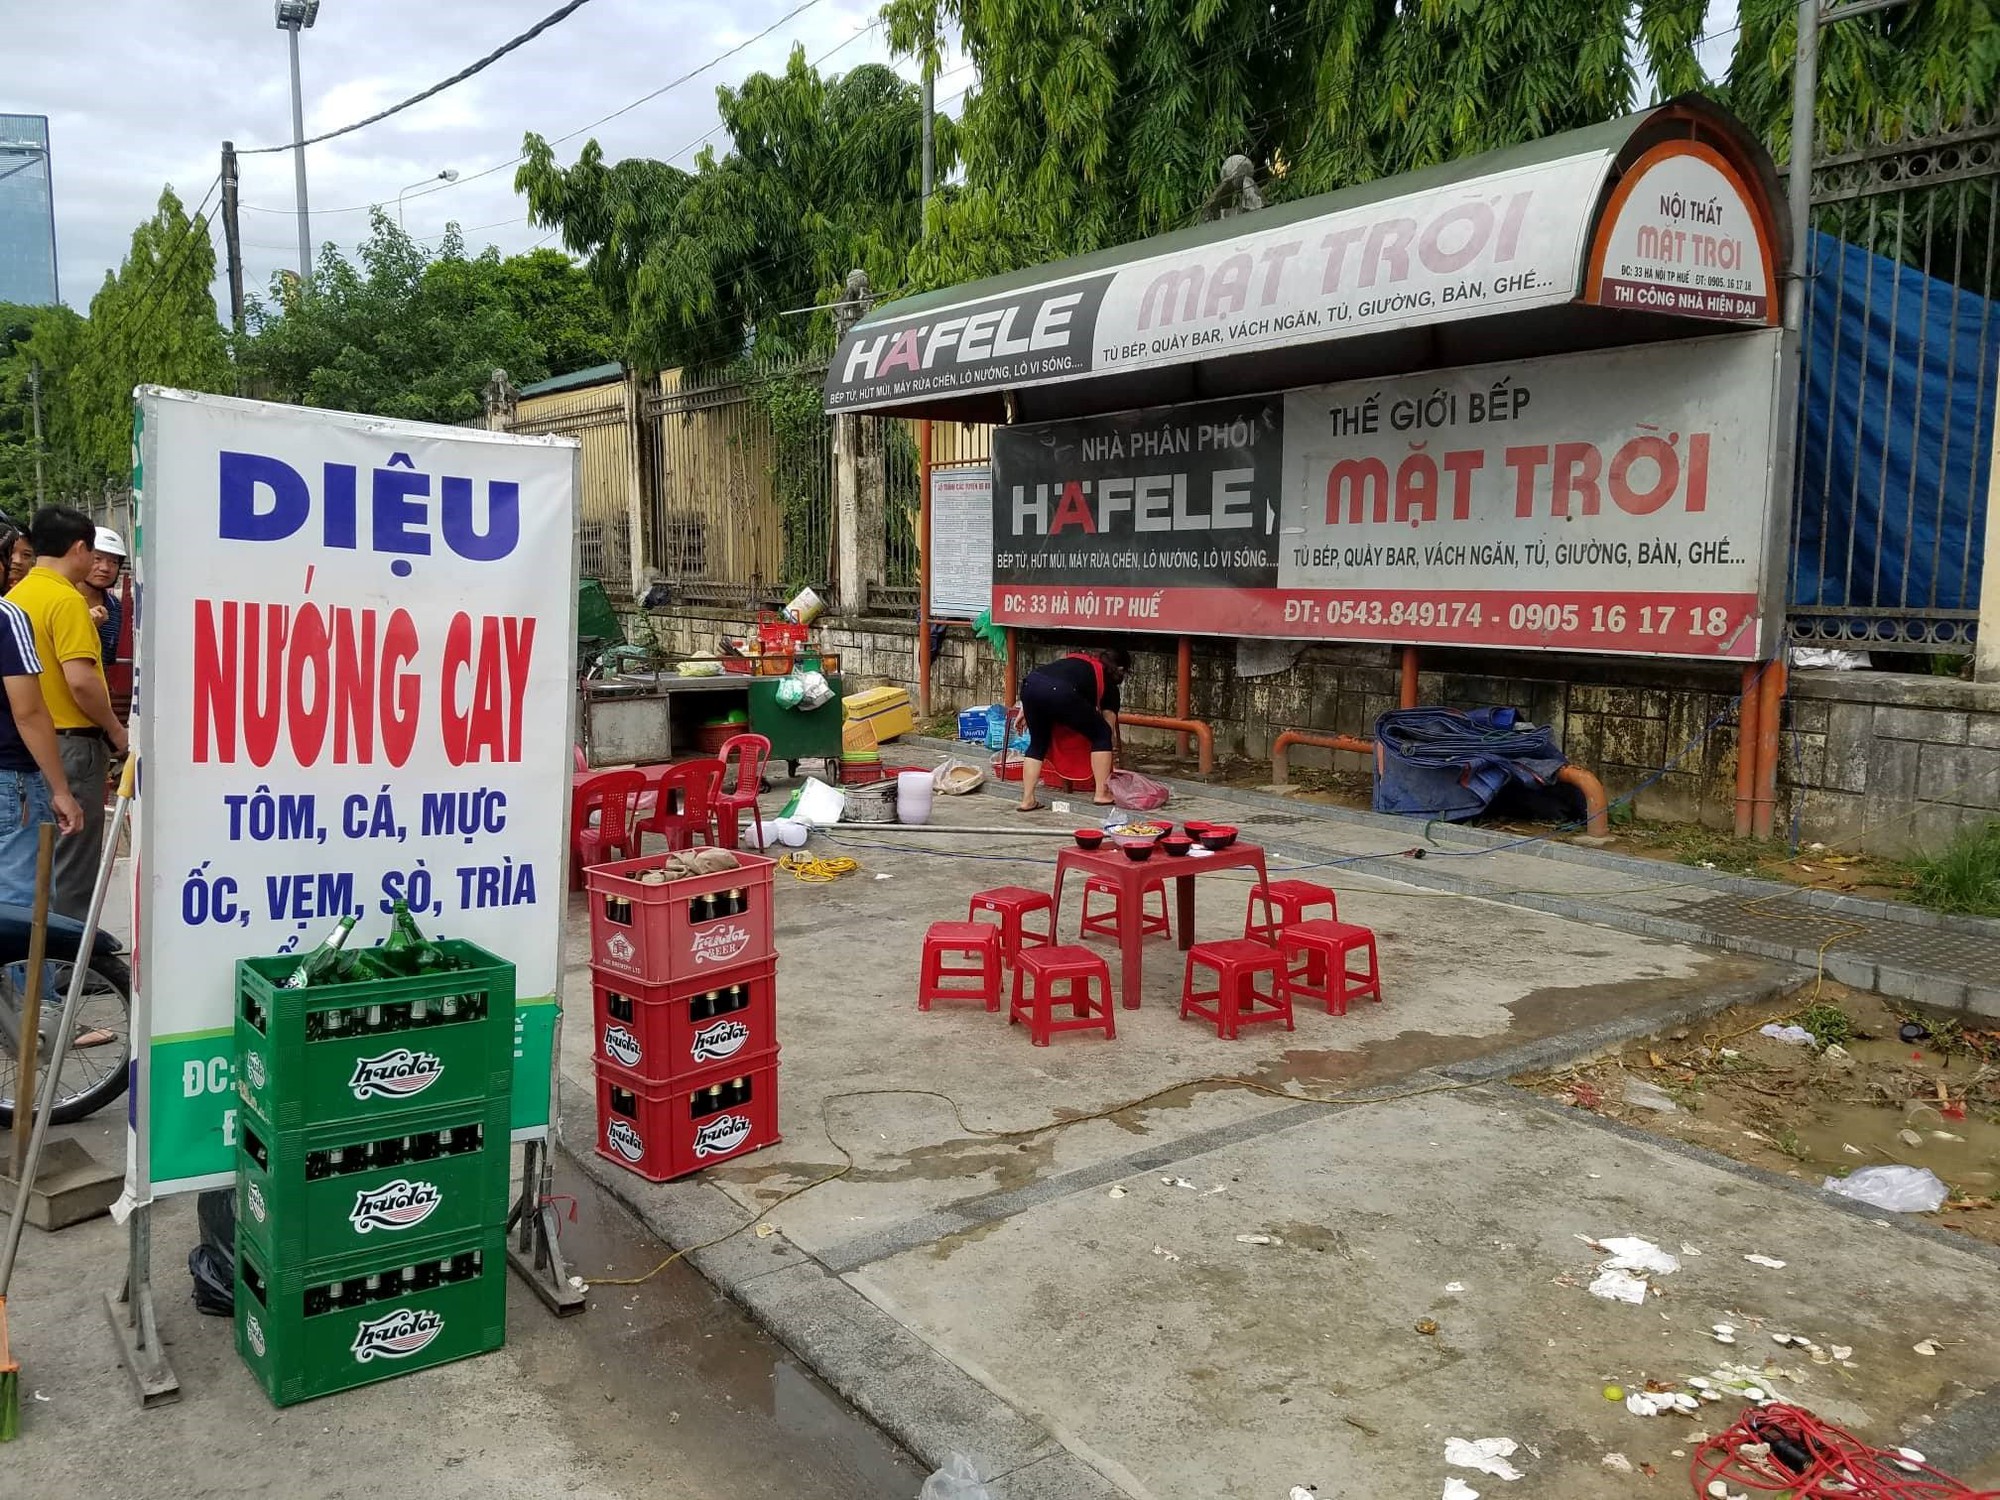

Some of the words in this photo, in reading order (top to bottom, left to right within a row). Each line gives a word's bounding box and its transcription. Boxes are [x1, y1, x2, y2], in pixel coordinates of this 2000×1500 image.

[1660, 192, 1686, 224] NỘI
[1690, 197, 1722, 225] THẤT
[1137, 240, 1302, 331] MẶT
[1320, 191, 1534, 295] TRỜI
[1637, 224, 1686, 264] MẶT
[1692, 233, 1741, 270] TRỜI
[1634, 266, 1643, 277] 33
[1644, 265, 1653, 279] HÀ
[1667, 270, 1676, 282] TP
[1677, 269, 1691, 284] HUẾ
[1727, 278, 1735, 289] 16
[1736, 279, 1744, 290] 17
[1102, 343, 1119, 362] TỦ
[1192, 329, 1224, 346] BAR,
[1229, 320, 1269, 340] VÁCH
[1273, 309, 1321, 332] NGĂN,
[1358, 291, 1436, 317] GIƯỜNG,
[1442, 281, 1486, 304] BÀN,
[1614, 285, 1634, 302] THI
[1637, 286, 1675, 306] CÔNG
[1678, 292, 1704, 311] NHÀ
[1707, 294, 1734, 316] HIỆN
[1736, 301, 1756, 318] ĐẠI
[859, 384, 875, 399] HÚT
[894, 380, 911, 394] MÁY
[913, 374, 931, 391] RỬA
[960, 368, 973, 383] LÒ
[974, 364, 1012, 382] NƯỚNG,
[1014, 360, 1028, 376] LÒ
[1030, 361, 1040, 374] VI
[1329, 391, 1382, 437] THẾ
[1390, 387, 1456, 431] GIỚI
[1469, 376, 1531, 423] BẾP
[1082, 428, 1125, 462] NHÀ
[1131, 424, 1190, 458] PHÂN
[1325, 440, 1485, 528] MẶT
[1505, 423, 1711, 518] TRỜI
[219, 450, 521, 577] DIỆU
[1031, 551, 1048, 569] HÚT
[1050, 550, 1067, 570] MÙI,
[1068, 549, 1090, 569] MÁY
[1090, 550, 1110, 569] RỬA
[1143, 549, 1157, 569] LÒ
[1159, 548, 1201, 571] NƯỚNG,
[1203, 547, 1218, 569] LÒ
[1221, 550, 1231, 568] VI
[1293, 544, 1309, 567] TỦ
[1386, 547, 1420, 569] BAR,
[1424, 541, 1466, 567] VÁCH
[1469, 540, 1519, 569] NGĂN,
[1525, 539, 1550, 569] TỦ,
[1555, 538, 1632, 568] GIƯỜNG,
[1637, 537, 1682, 569] BÀN,
[1004, 594, 1026, 612] ĐC:
[1029, 594, 1047, 613] 33
[1051, 590, 1070, 615] HÀ
[1074, 591, 1100, 619] NỘI
[1104, 596, 1124, 618] TP
[1128, 589, 1165, 618] HUẾ
[1284, 599, 1320, 623] ĐT:
[1326, 600, 1482, 628] 0543.849174
[1508, 603, 1579, 631] 0905
[1590, 605, 1627, 634] 16
[1638, 606, 1677, 635] 17
[1688, 607, 1728, 636] 18
[192, 565, 422, 768] NƯỚNG
[441, 611, 537, 767] CAY
[224, 784, 327, 844] TÔM,
[342, 784, 408, 843] CÁ,
[421, 786, 508, 844] MỰC
[181, 860, 251, 926] ỐC,
[267, 872, 364, 930] VẸM,
[381, 859, 443, 918] SÒ,
[456, 855, 537, 909] TRÌA
[182, 1056, 236, 1098] ĐC:
